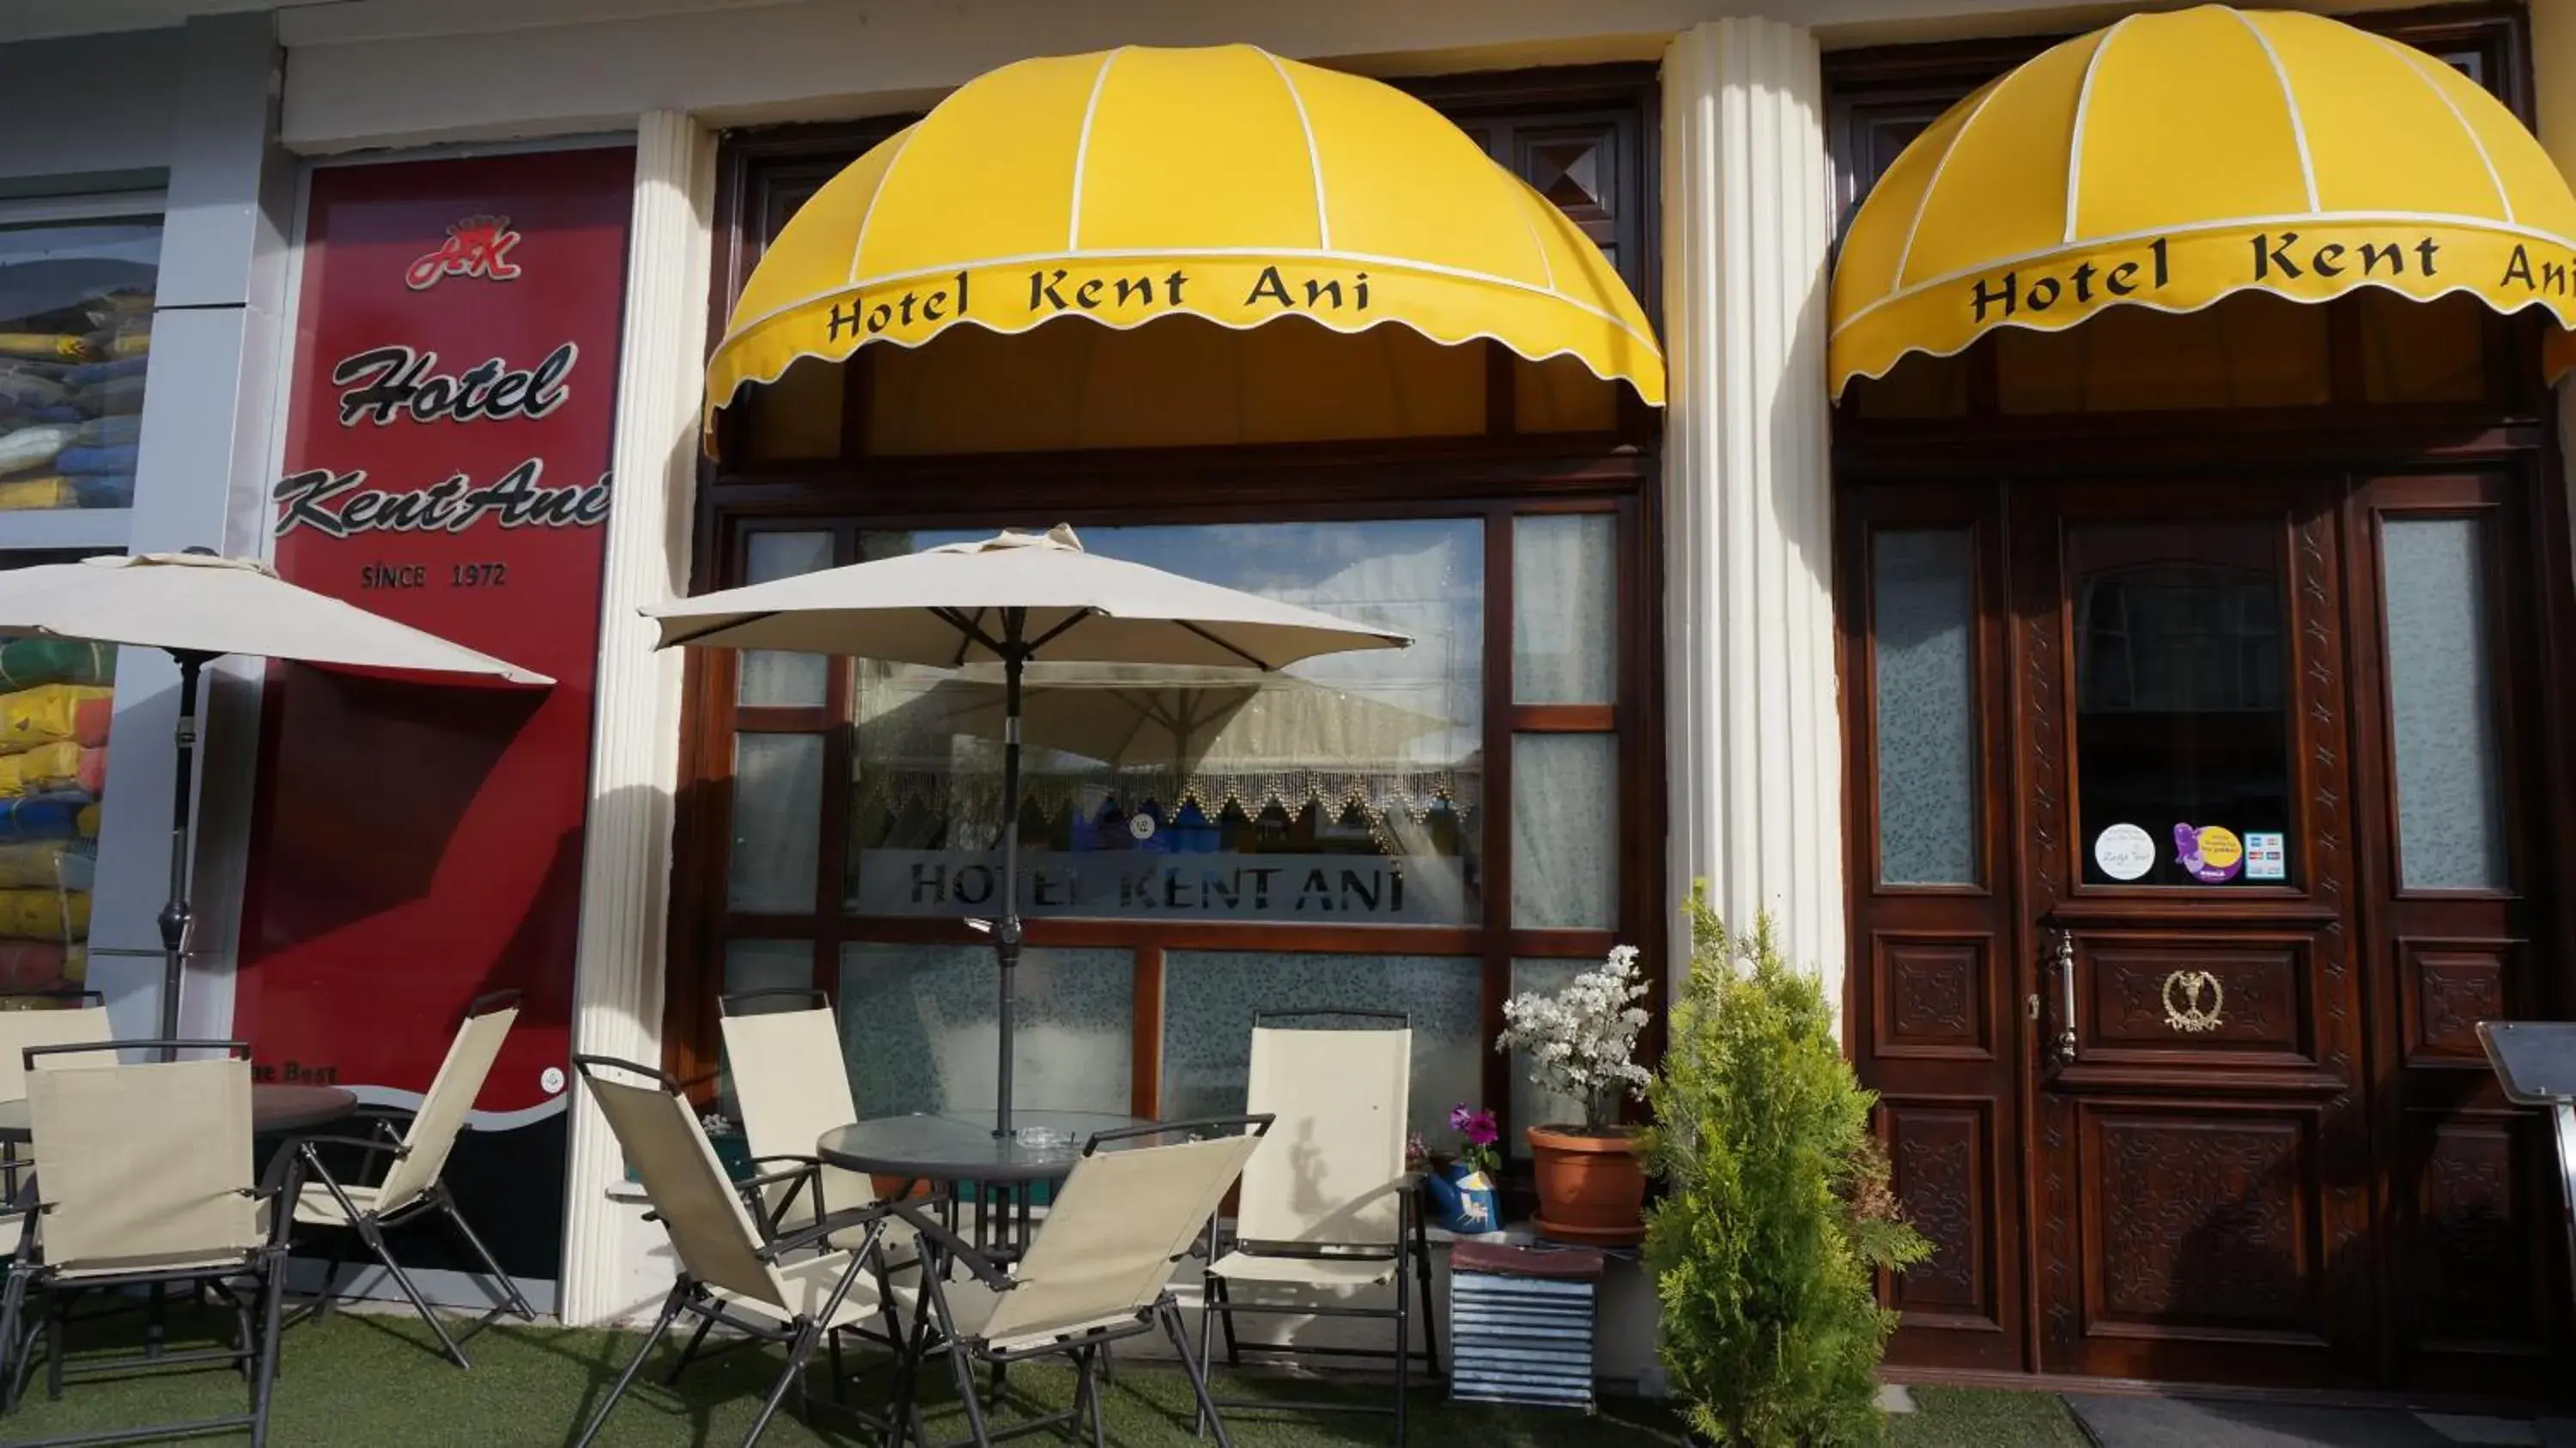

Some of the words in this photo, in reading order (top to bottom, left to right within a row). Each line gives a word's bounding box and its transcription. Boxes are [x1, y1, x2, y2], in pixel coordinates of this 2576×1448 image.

[829, 271, 969, 343] Hotel
[1030, 269, 1188, 311] Kent
[1246, 266, 1368, 310] Ani
[1970, 237, 2170, 324] Hotel
[2249, 233, 2440, 281] Kent
[332, 340, 578, 426] Hotel
[452, 563, 508, 587] 1972
[1119, 866, 1285, 910] KENT
